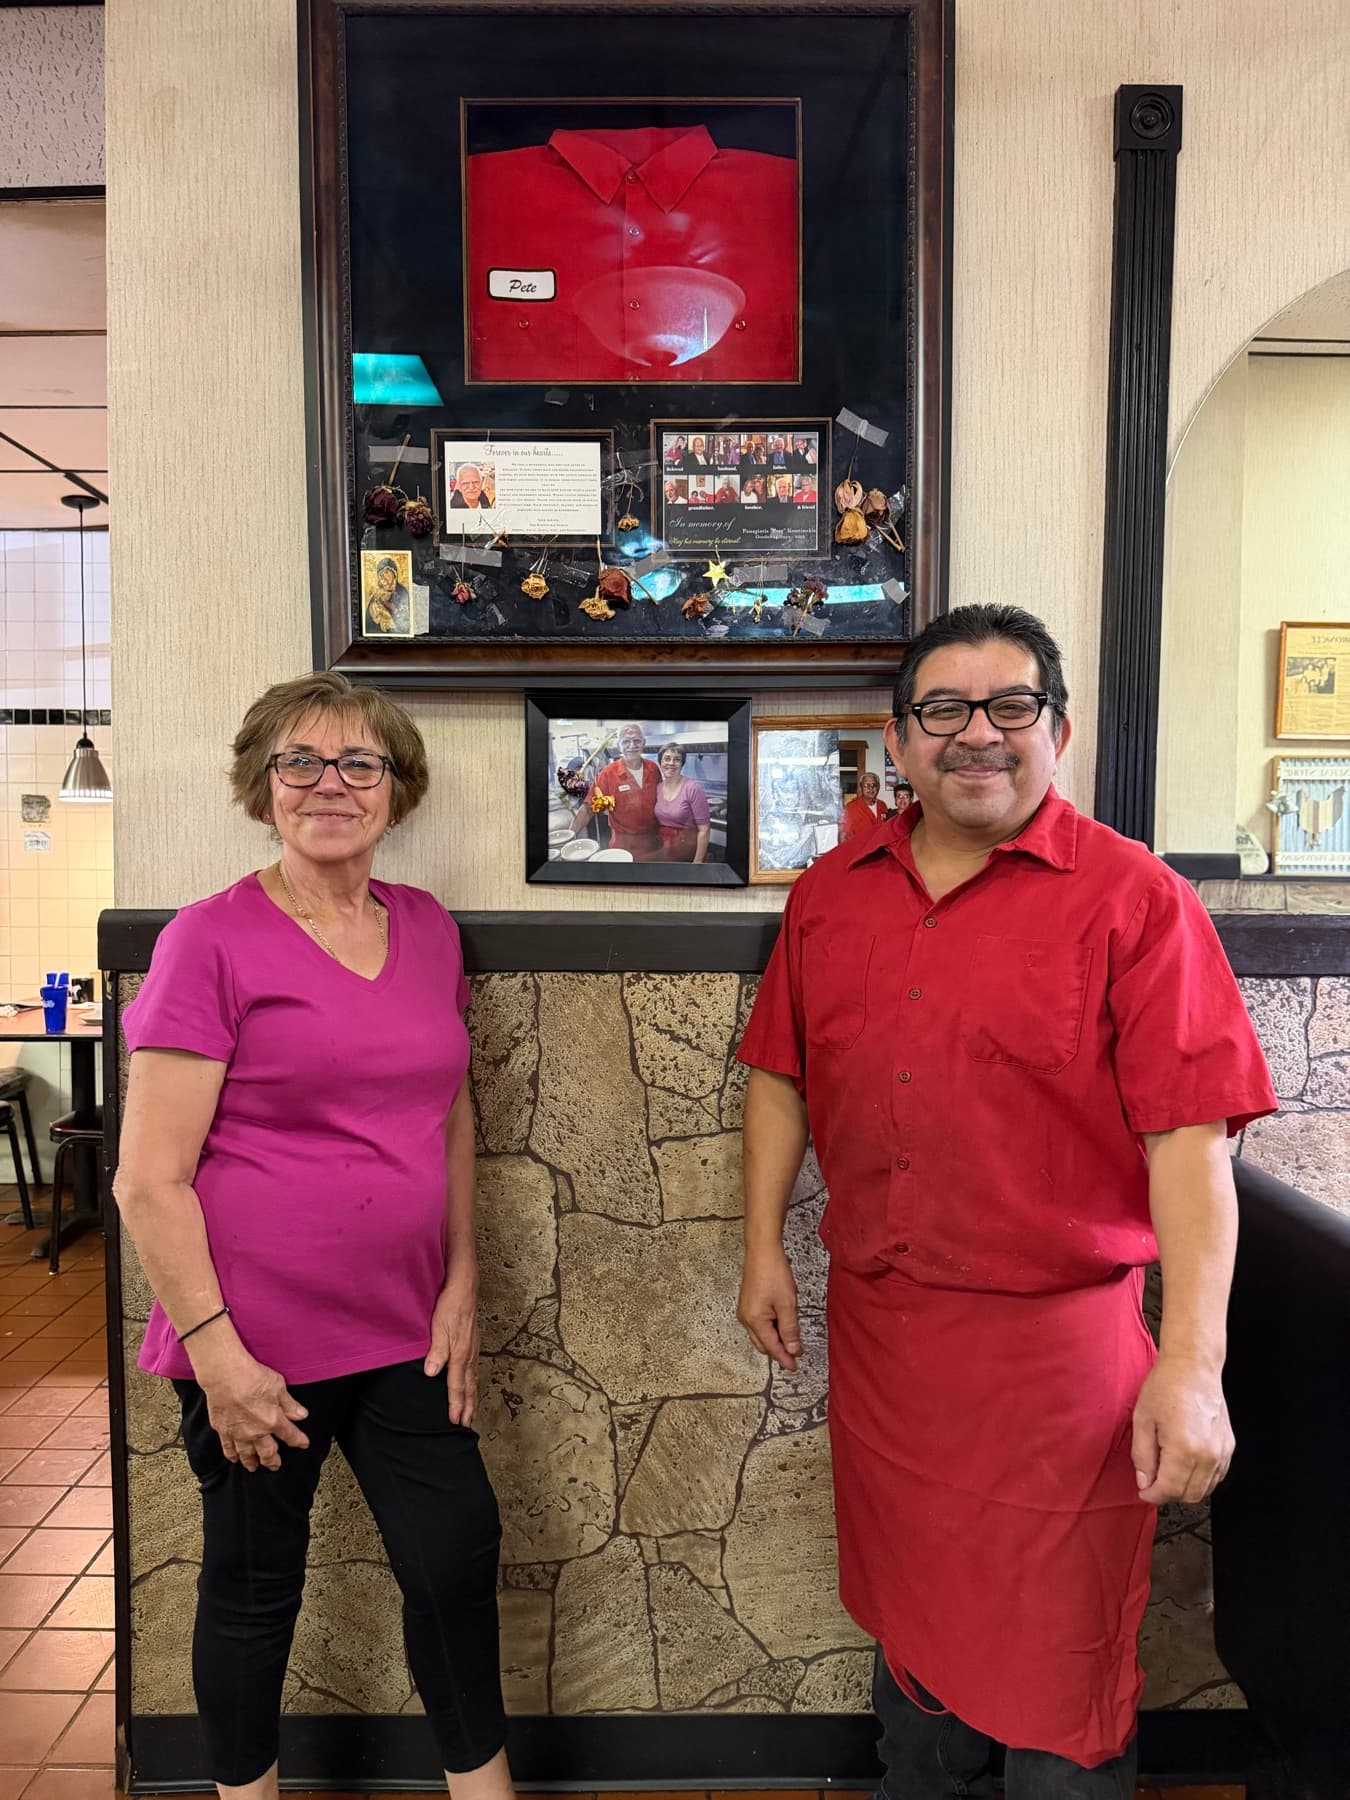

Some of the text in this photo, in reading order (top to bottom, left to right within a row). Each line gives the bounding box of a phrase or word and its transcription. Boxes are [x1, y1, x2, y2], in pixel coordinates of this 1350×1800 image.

[509, 279, 537, 293] Pete
[483, 444, 511, 456] Forever
[512, 448, 519, 456] in
[669, 516, 737, 532] In memory of
